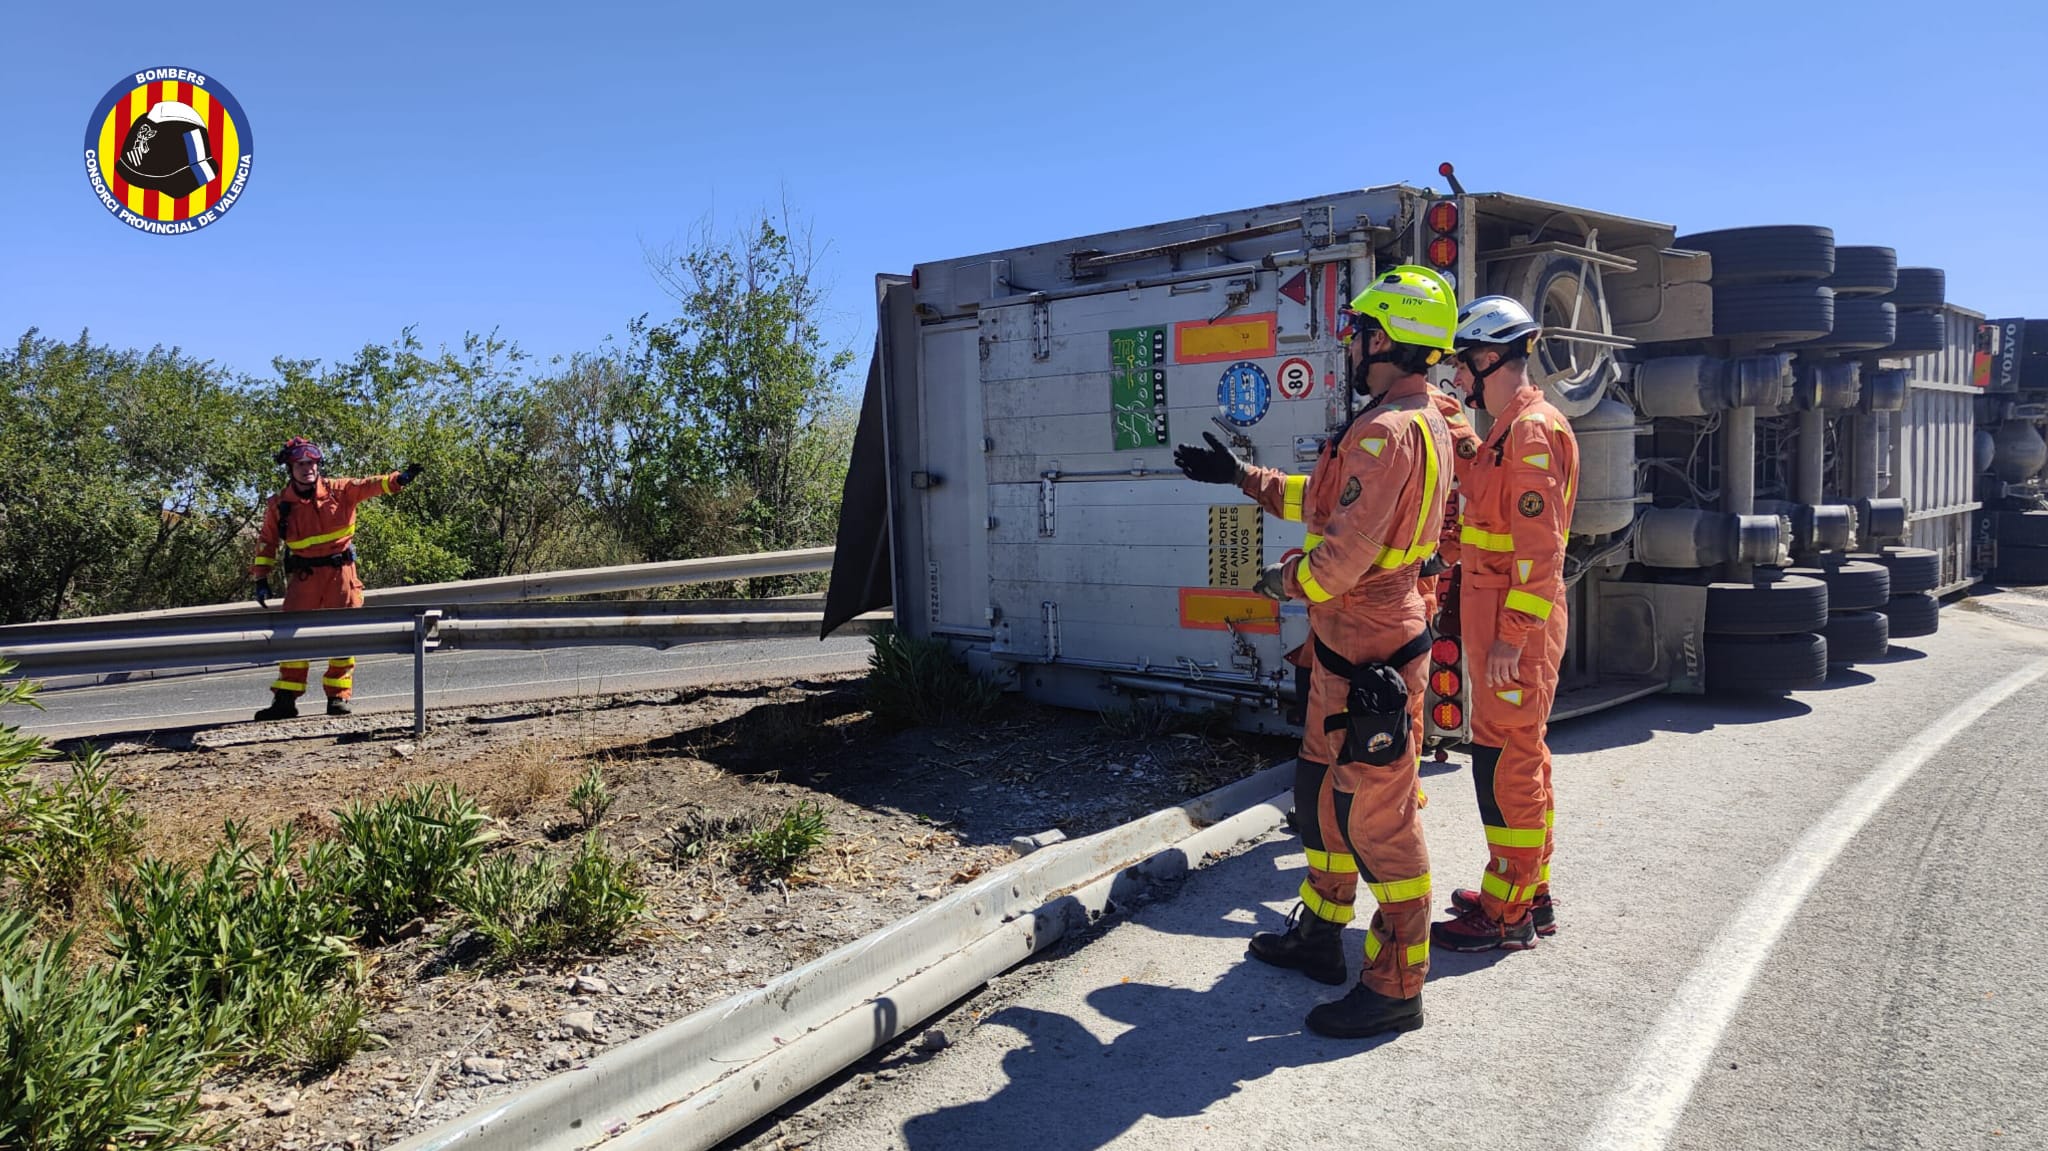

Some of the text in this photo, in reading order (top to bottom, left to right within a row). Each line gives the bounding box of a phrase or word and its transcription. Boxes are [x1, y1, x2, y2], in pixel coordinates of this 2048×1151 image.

[1288, 368, 1303, 390] 80
[2001, 323, 2016, 387] VOLVO
[1219, 506, 1228, 586] TRANSPORTE
[1230, 506, 1239, 586] DE ANIMALES
[1241, 528, 1250, 565] VIVOS
